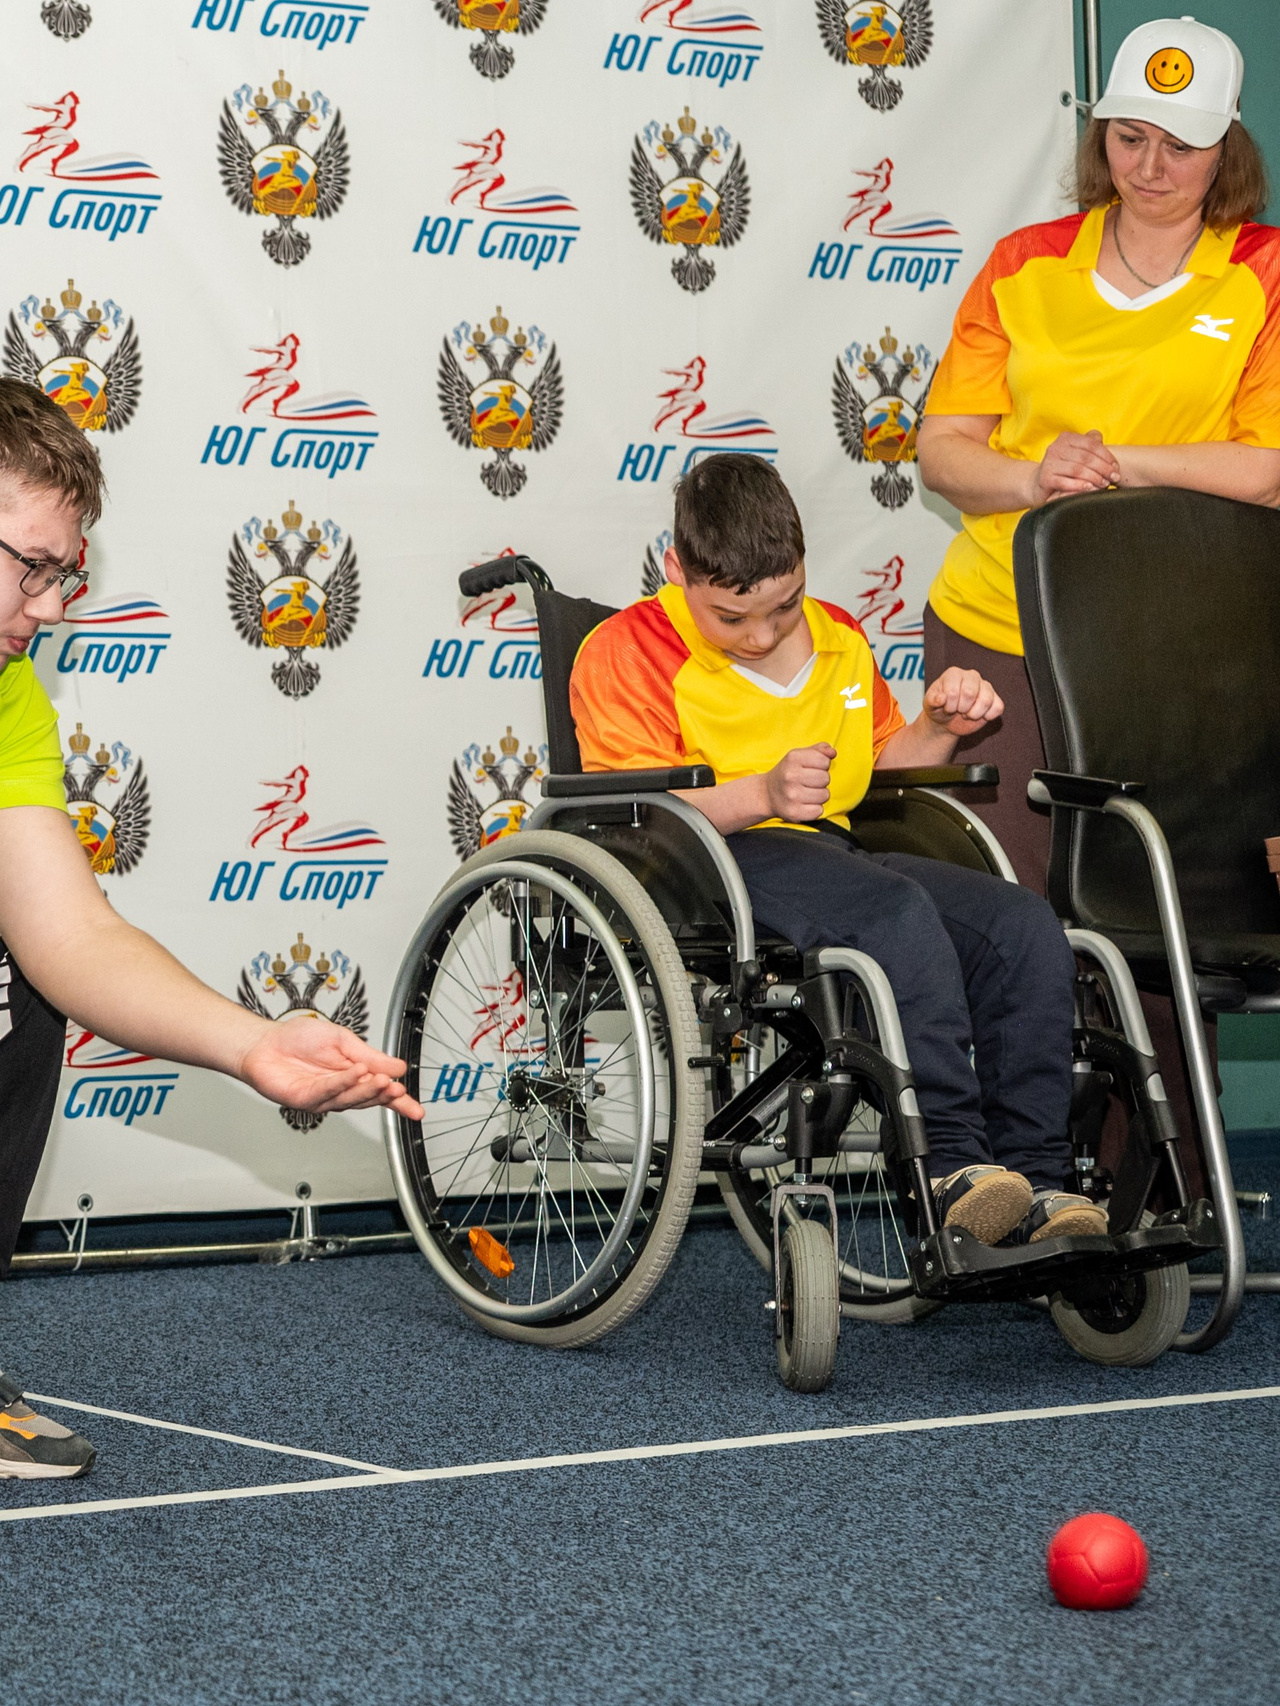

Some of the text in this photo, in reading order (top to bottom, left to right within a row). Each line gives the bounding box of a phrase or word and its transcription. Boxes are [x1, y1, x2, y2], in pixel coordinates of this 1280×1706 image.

[191, 0, 370, 50] ЮГ Спорт
[604, 34, 764, 88] ЮГ Спорт
[49, 188, 163, 242] Спорт
[413, 216, 581, 271] ЮГ Спорт
[808, 243, 963, 292] ЮГ Спорт
[201, 426, 380, 480] ЮГ Спорт
[617, 443, 677, 483] ЮГ
[28, 631, 172, 684] Г Спорт
[421, 638, 543, 680] ЮГ Спо
[209, 859, 389, 910] ЮГ Спорт
[63, 1073, 180, 1127] Спорт
[431, 1062, 494, 1104] ЮГ
